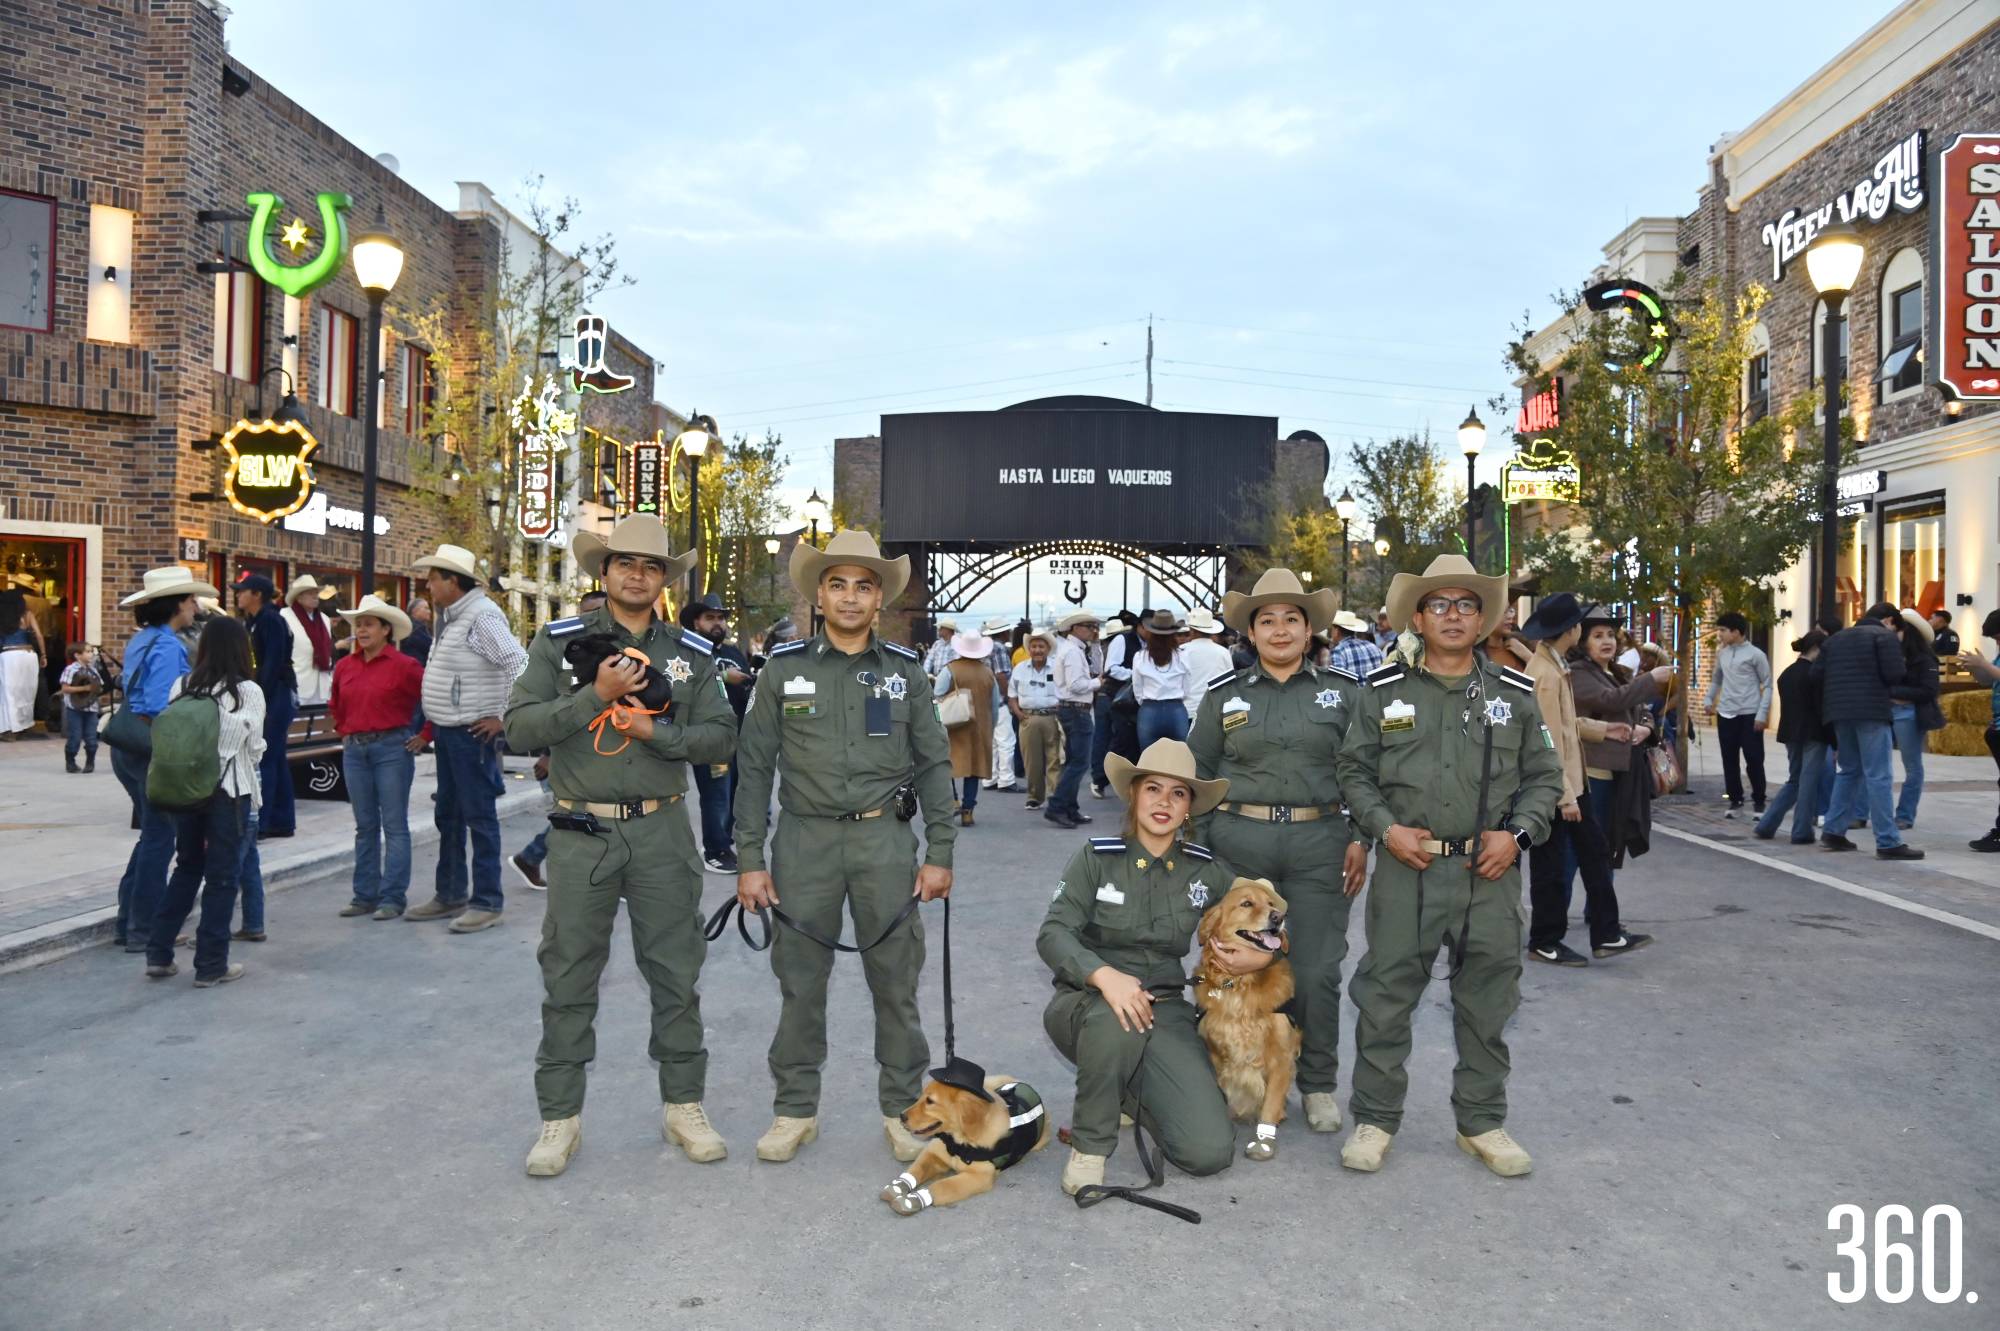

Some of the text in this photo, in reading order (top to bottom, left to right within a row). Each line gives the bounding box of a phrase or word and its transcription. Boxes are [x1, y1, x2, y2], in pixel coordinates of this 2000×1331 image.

[1966, 163, 2000, 368] SALOON
[238, 455, 297, 487] SLW
[639, 448, 658, 503] HONKY
[999, 468, 1172, 486] HASTA LUEGO VAQUEROS
